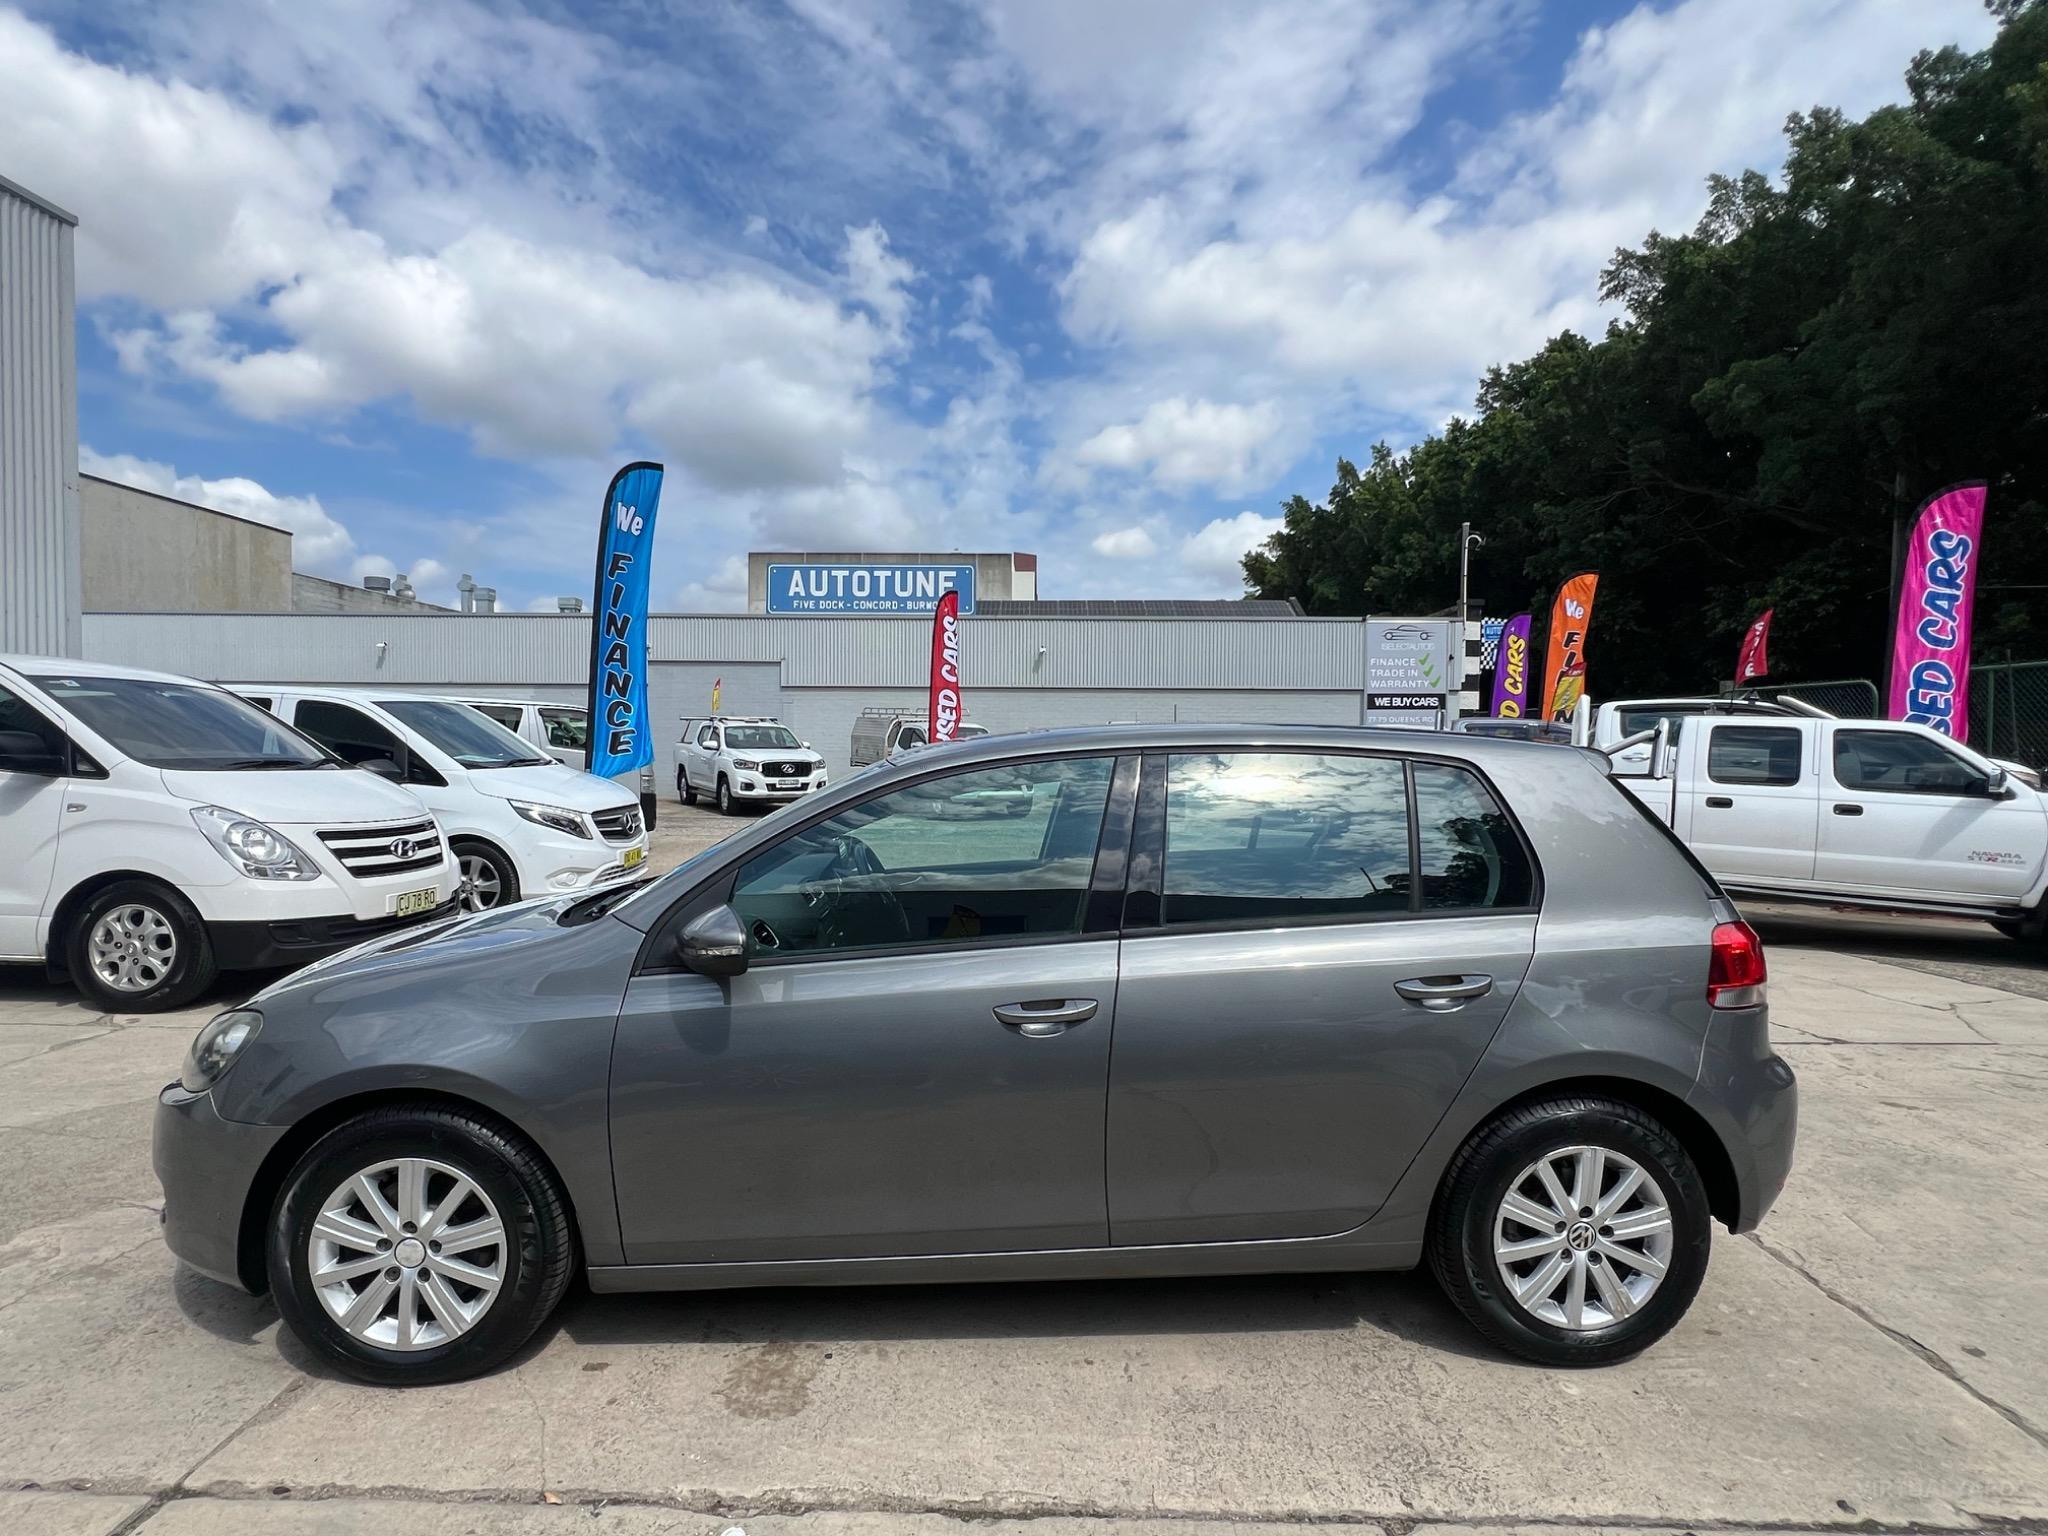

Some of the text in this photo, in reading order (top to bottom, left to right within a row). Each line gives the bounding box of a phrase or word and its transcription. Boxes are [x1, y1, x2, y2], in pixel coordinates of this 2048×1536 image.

[616, 502, 644, 536] We
[1915, 528, 1972, 650] CARS
[793, 600, 816, 610] FIVE
[819, 600, 845, 610] DOCK
[853, 600, 898, 610] CONCORD
[906, 600, 937, 611] BURWO
[1564, 598, 1584, 620] We
[604, 553, 637, 757] FINANCE
[1370, 658, 1416, 667] FINANCE
[1370, 669, 1418, 677] TRADE IN
[1504, 633, 1526, 696] CARS
[1370, 679, 1430, 688] WARRANTY
[1374, 697, 1439, 707] WE BUY CARS
[399, 895, 410, 912] CJ
